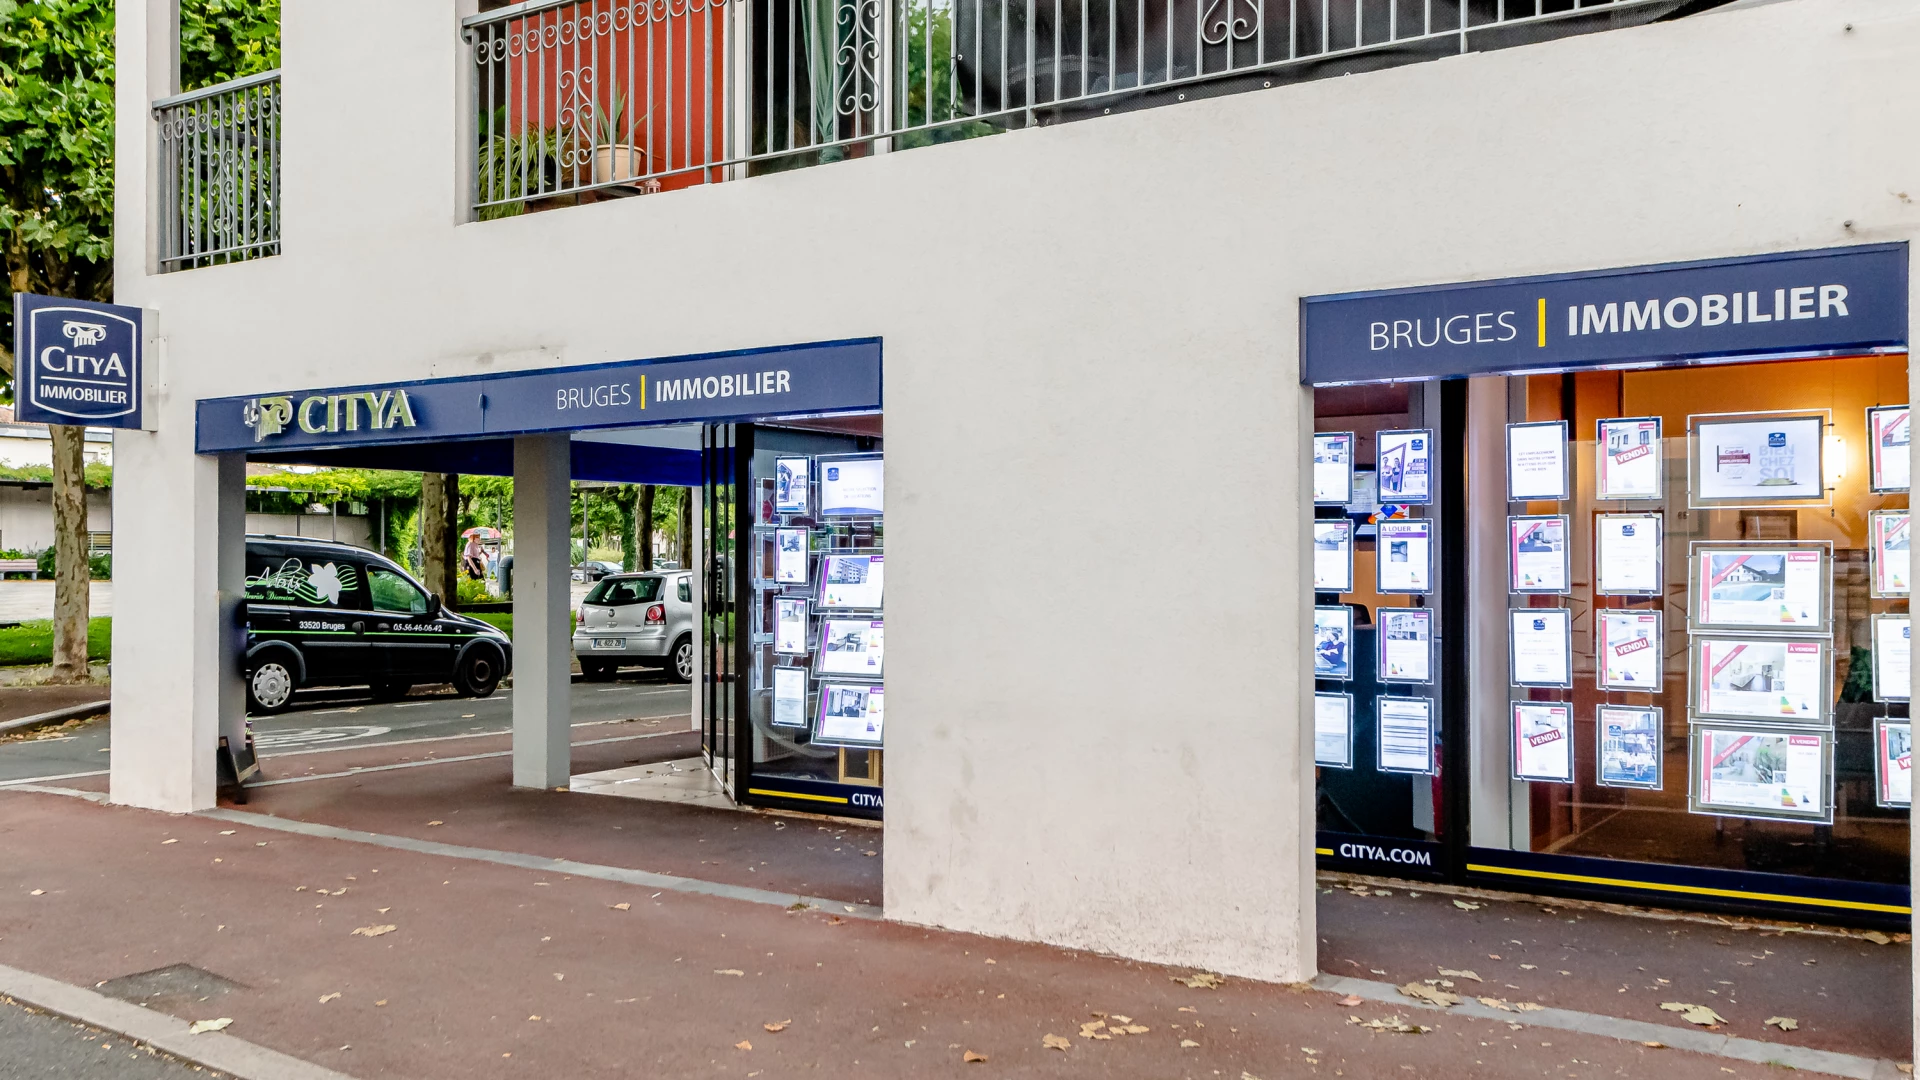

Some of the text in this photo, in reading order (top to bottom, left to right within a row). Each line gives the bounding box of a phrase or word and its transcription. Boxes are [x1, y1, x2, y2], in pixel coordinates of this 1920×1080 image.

[1369, 284, 1850, 351] BRUGES IMMOBILIER
[41, 346, 127, 377] CITYA
[40, 384, 127, 404] IMMOBILIER
[557, 370, 791, 410] BRUGES IMMOBILIER
[298, 389, 416, 434] CITYA
[1617, 447, 1647, 463] VENDU
[299, 620, 346, 631] 33520 Bruges
[1617, 639, 1647, 655] VENDU
[1530, 731, 1559, 746] VENDU
[1340, 843, 1431, 866] CITYA.COM
